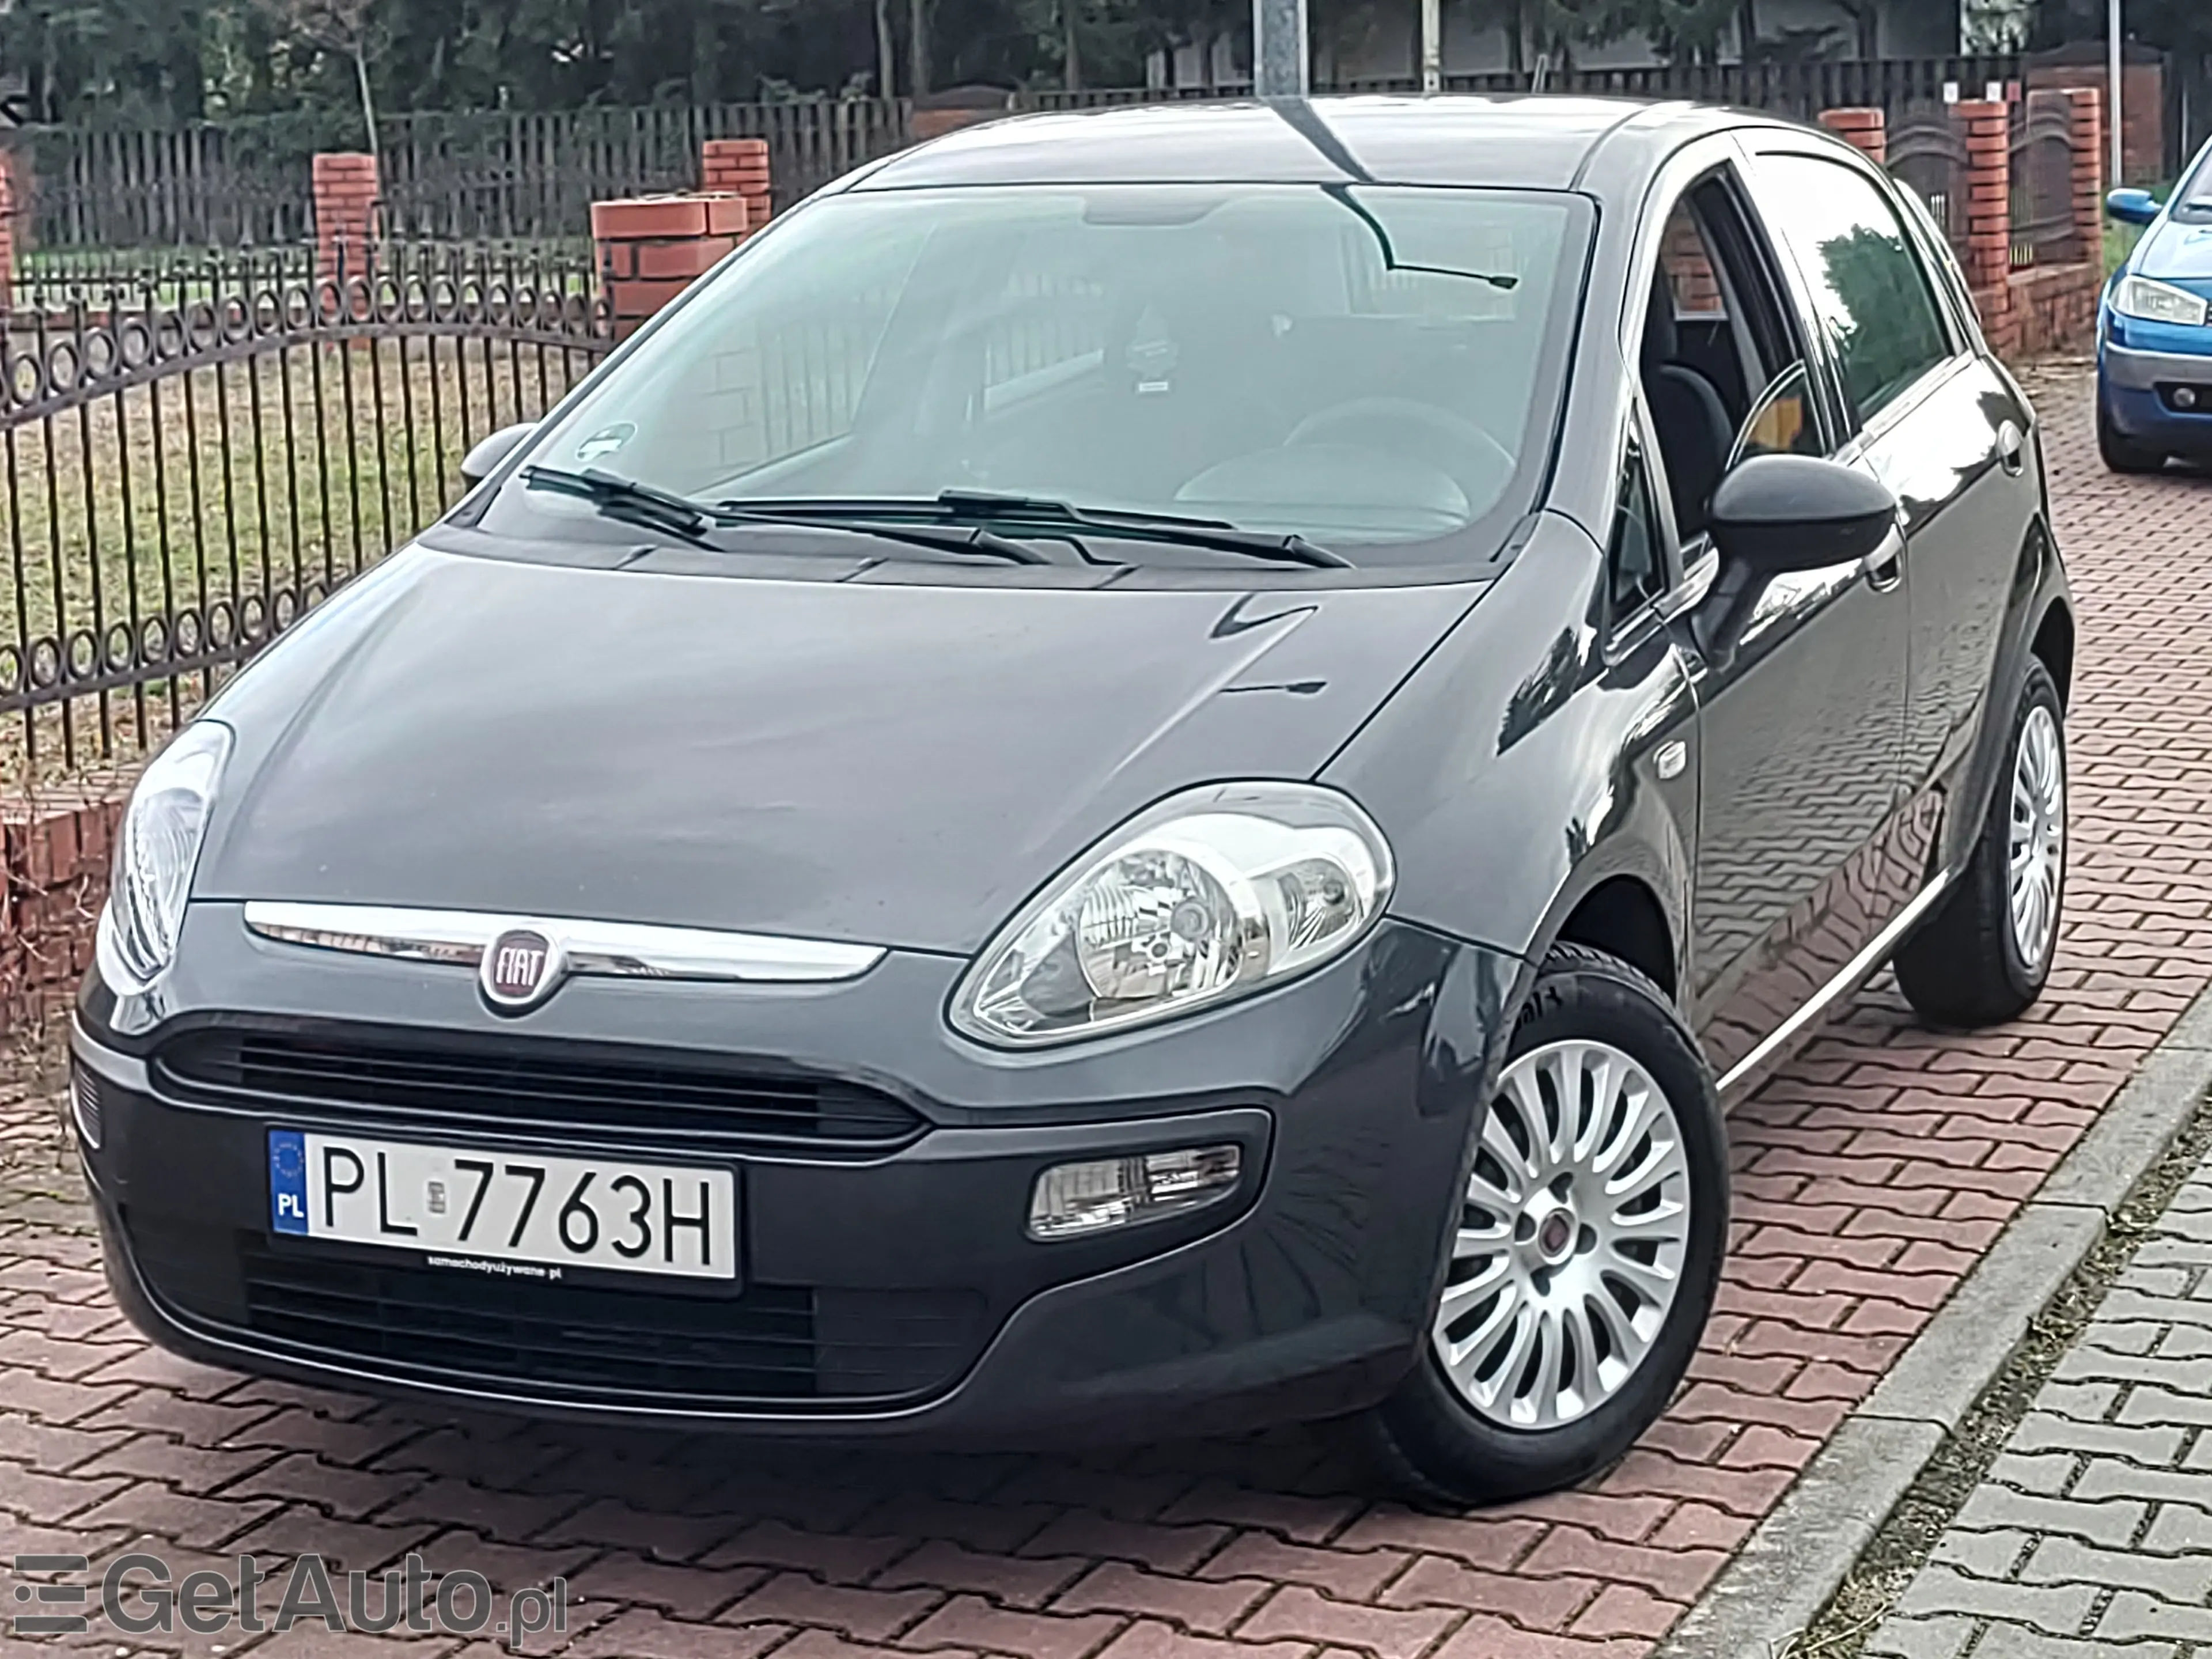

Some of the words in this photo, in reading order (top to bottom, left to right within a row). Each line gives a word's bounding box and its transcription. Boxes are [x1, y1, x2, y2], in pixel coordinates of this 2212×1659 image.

[496, 947, 544, 986] FIAT
[278, 1193, 304, 1218] PL
[323, 1146, 418, 1236] PL
[454, 1159, 711, 1265] 7763H
